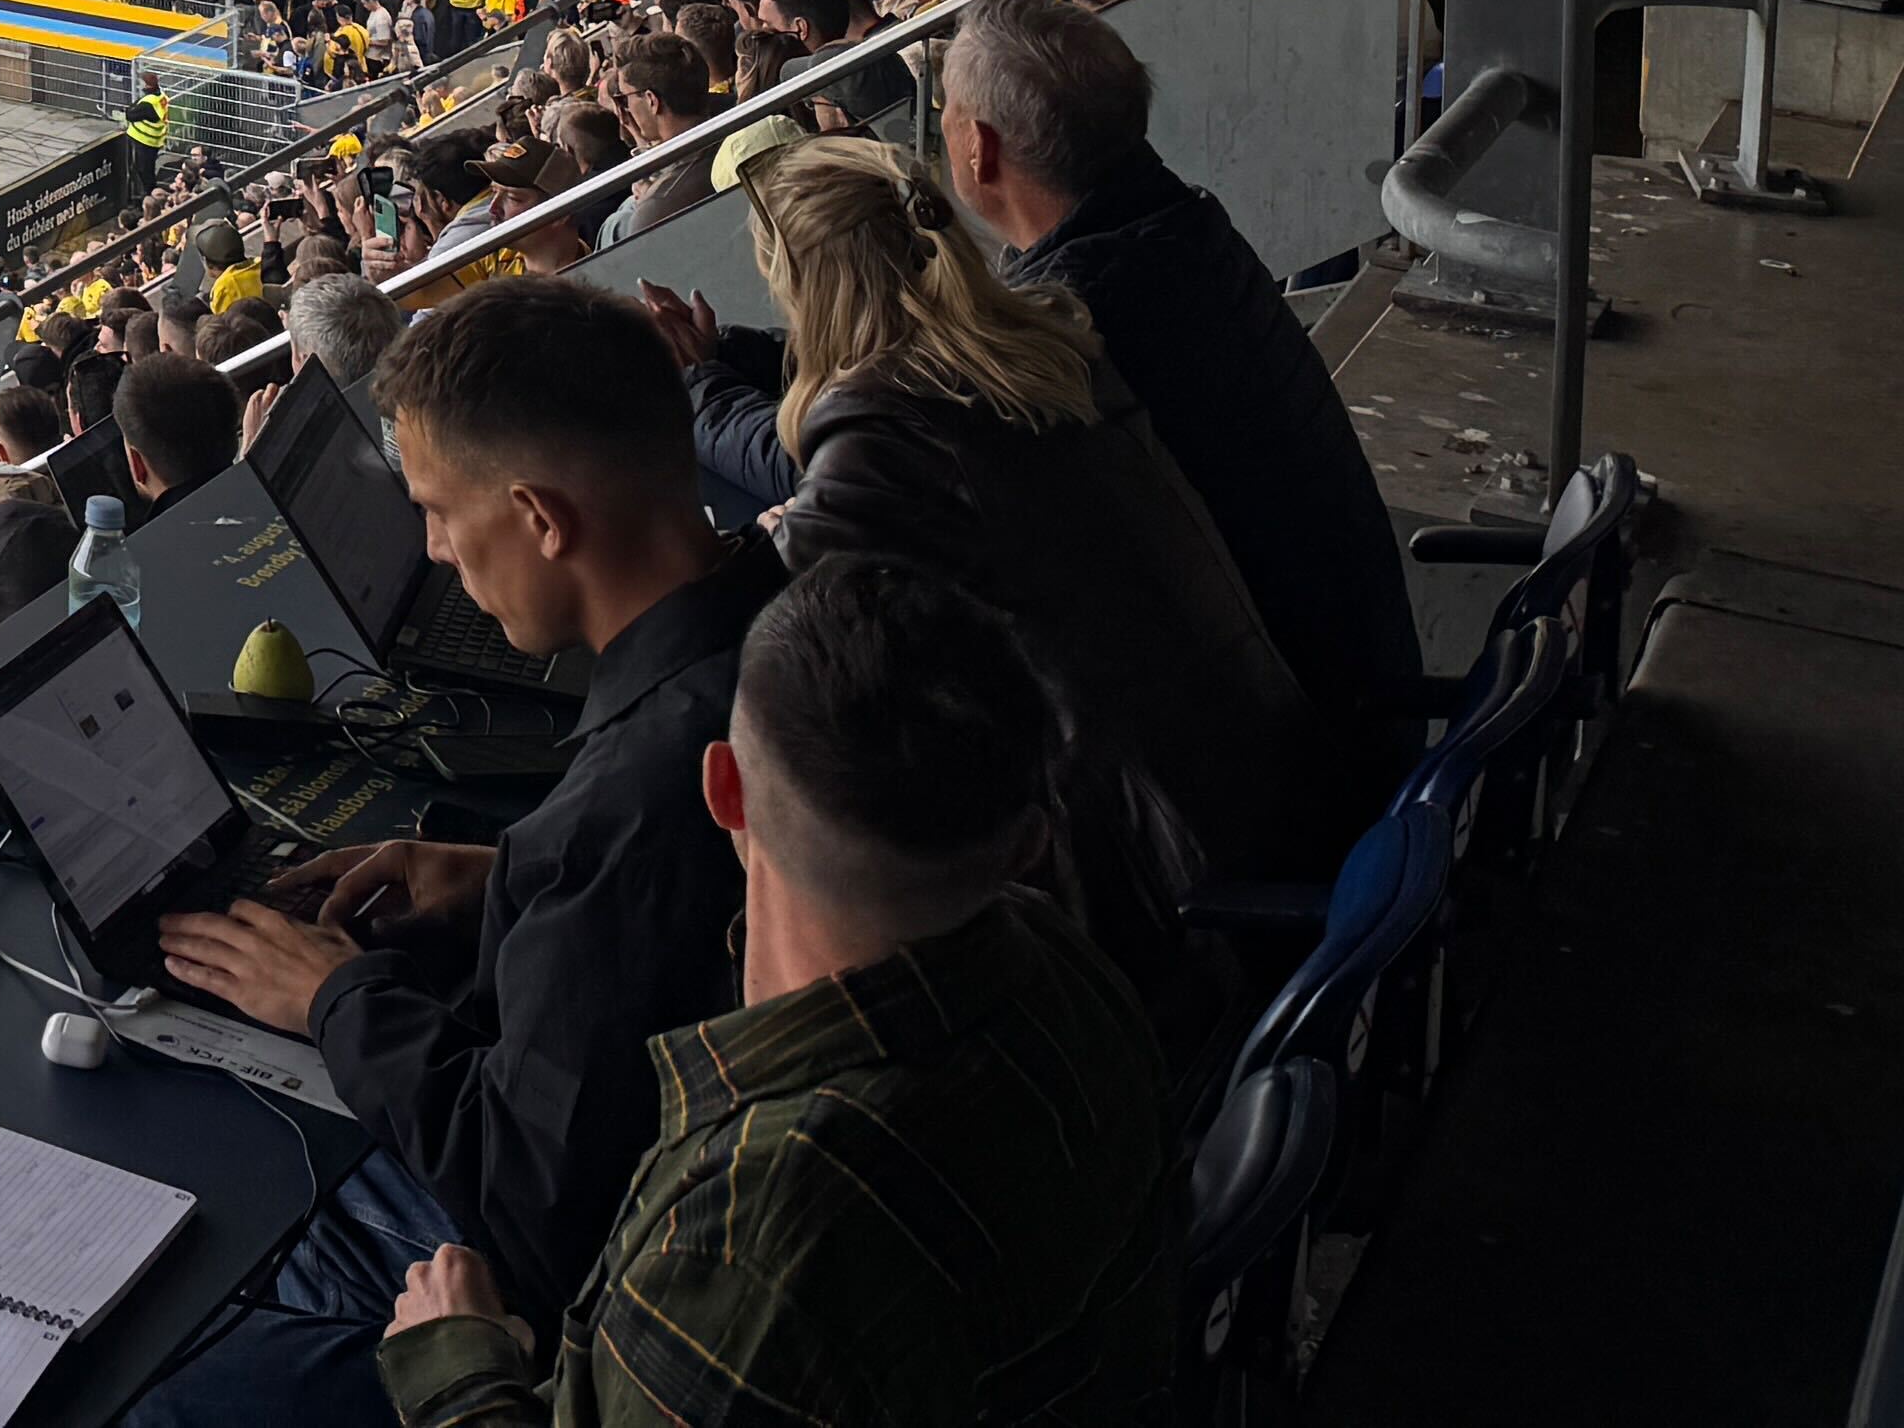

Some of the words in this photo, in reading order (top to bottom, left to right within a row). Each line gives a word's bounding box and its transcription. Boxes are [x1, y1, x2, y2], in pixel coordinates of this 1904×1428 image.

[6, 199, 34, 229] Husk
[35, 170, 94, 214] sidemanden
[95, 158, 113, 181] når
[6, 233, 20, 254] du
[22, 215, 56, 246] dribler
[56, 204, 75, 225] ned
